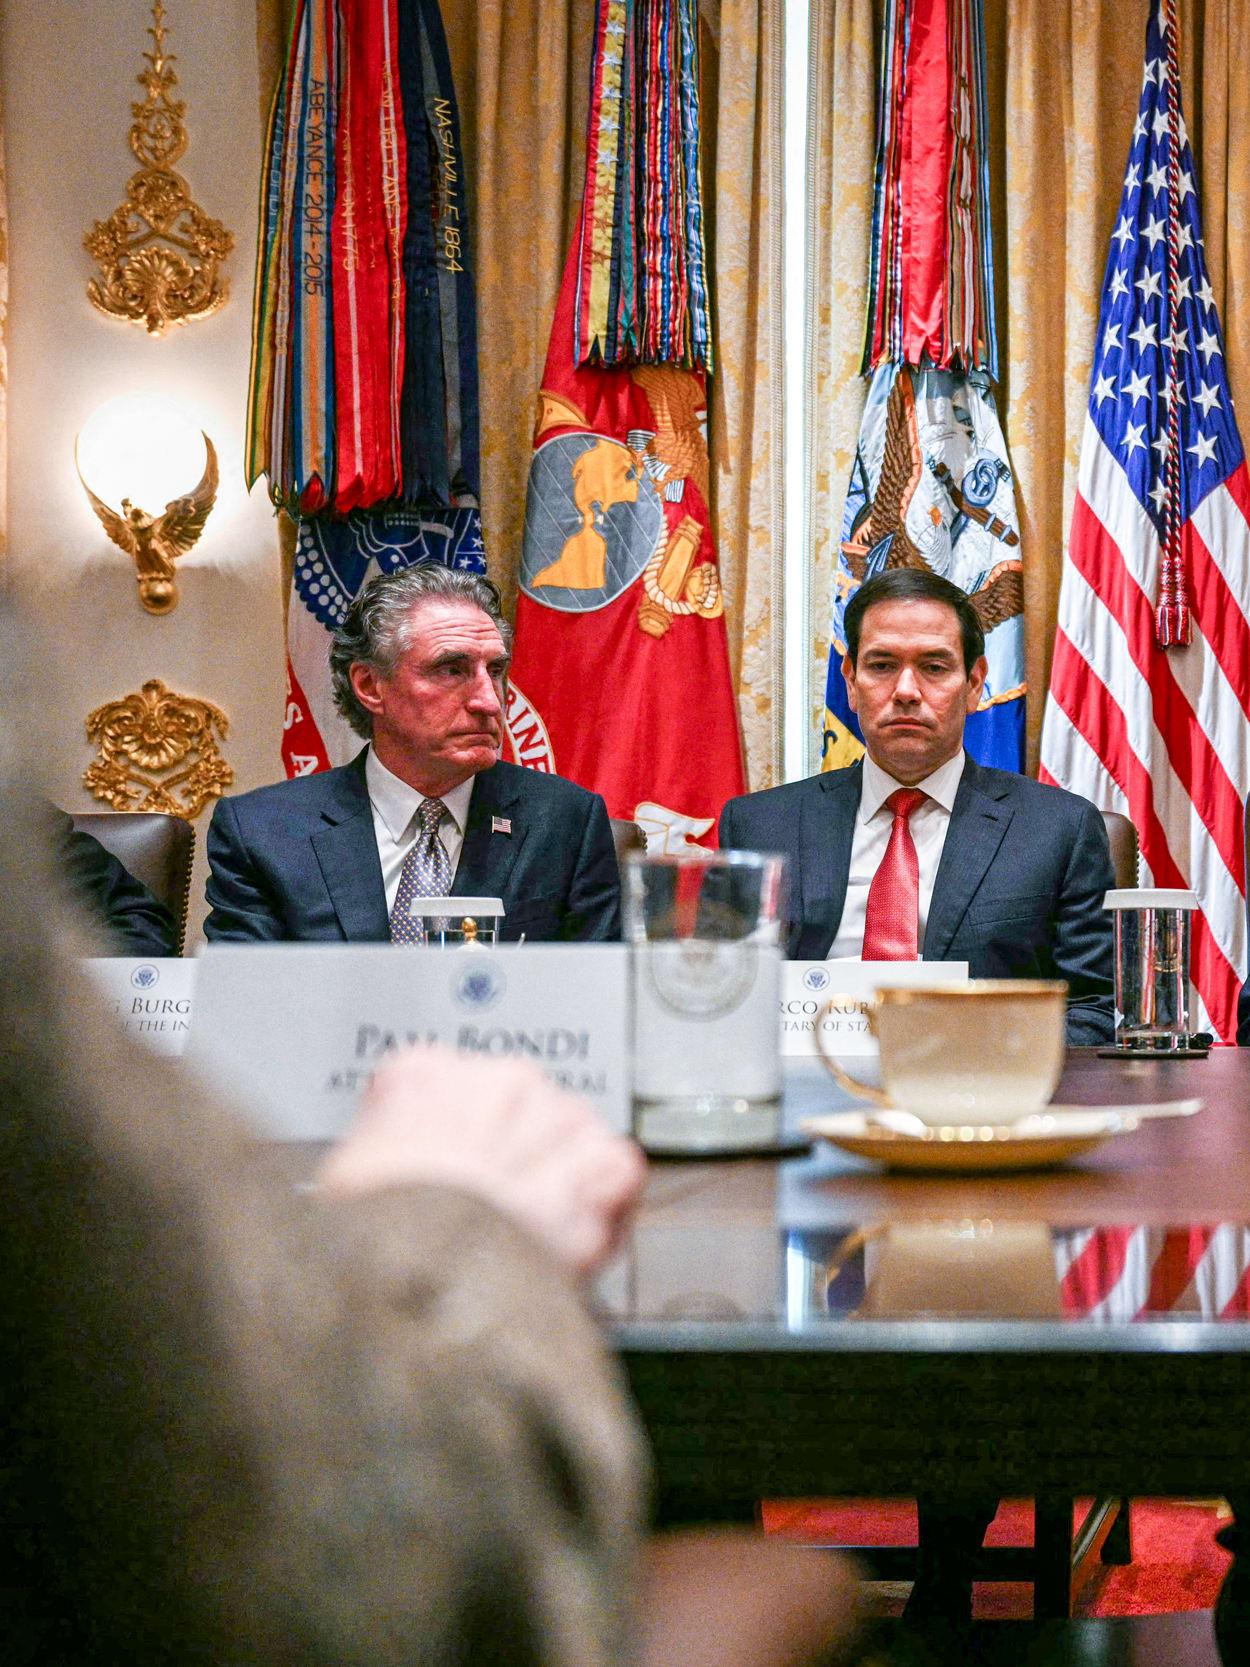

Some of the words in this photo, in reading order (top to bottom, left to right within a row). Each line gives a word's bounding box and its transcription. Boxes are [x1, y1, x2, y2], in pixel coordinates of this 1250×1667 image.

[305, 78, 325, 185] ABEYANCE
[434, 97, 459, 222] NASHVILLE
[303, 193, 324, 296] 2014-2015
[444, 226, 464, 275] 1864
[131, 997, 191, 1014] BURG
[137, 1020, 166, 1032] THE
[823, 1021, 843, 1032] OF
[457, 1024, 590, 1059] BONDI
